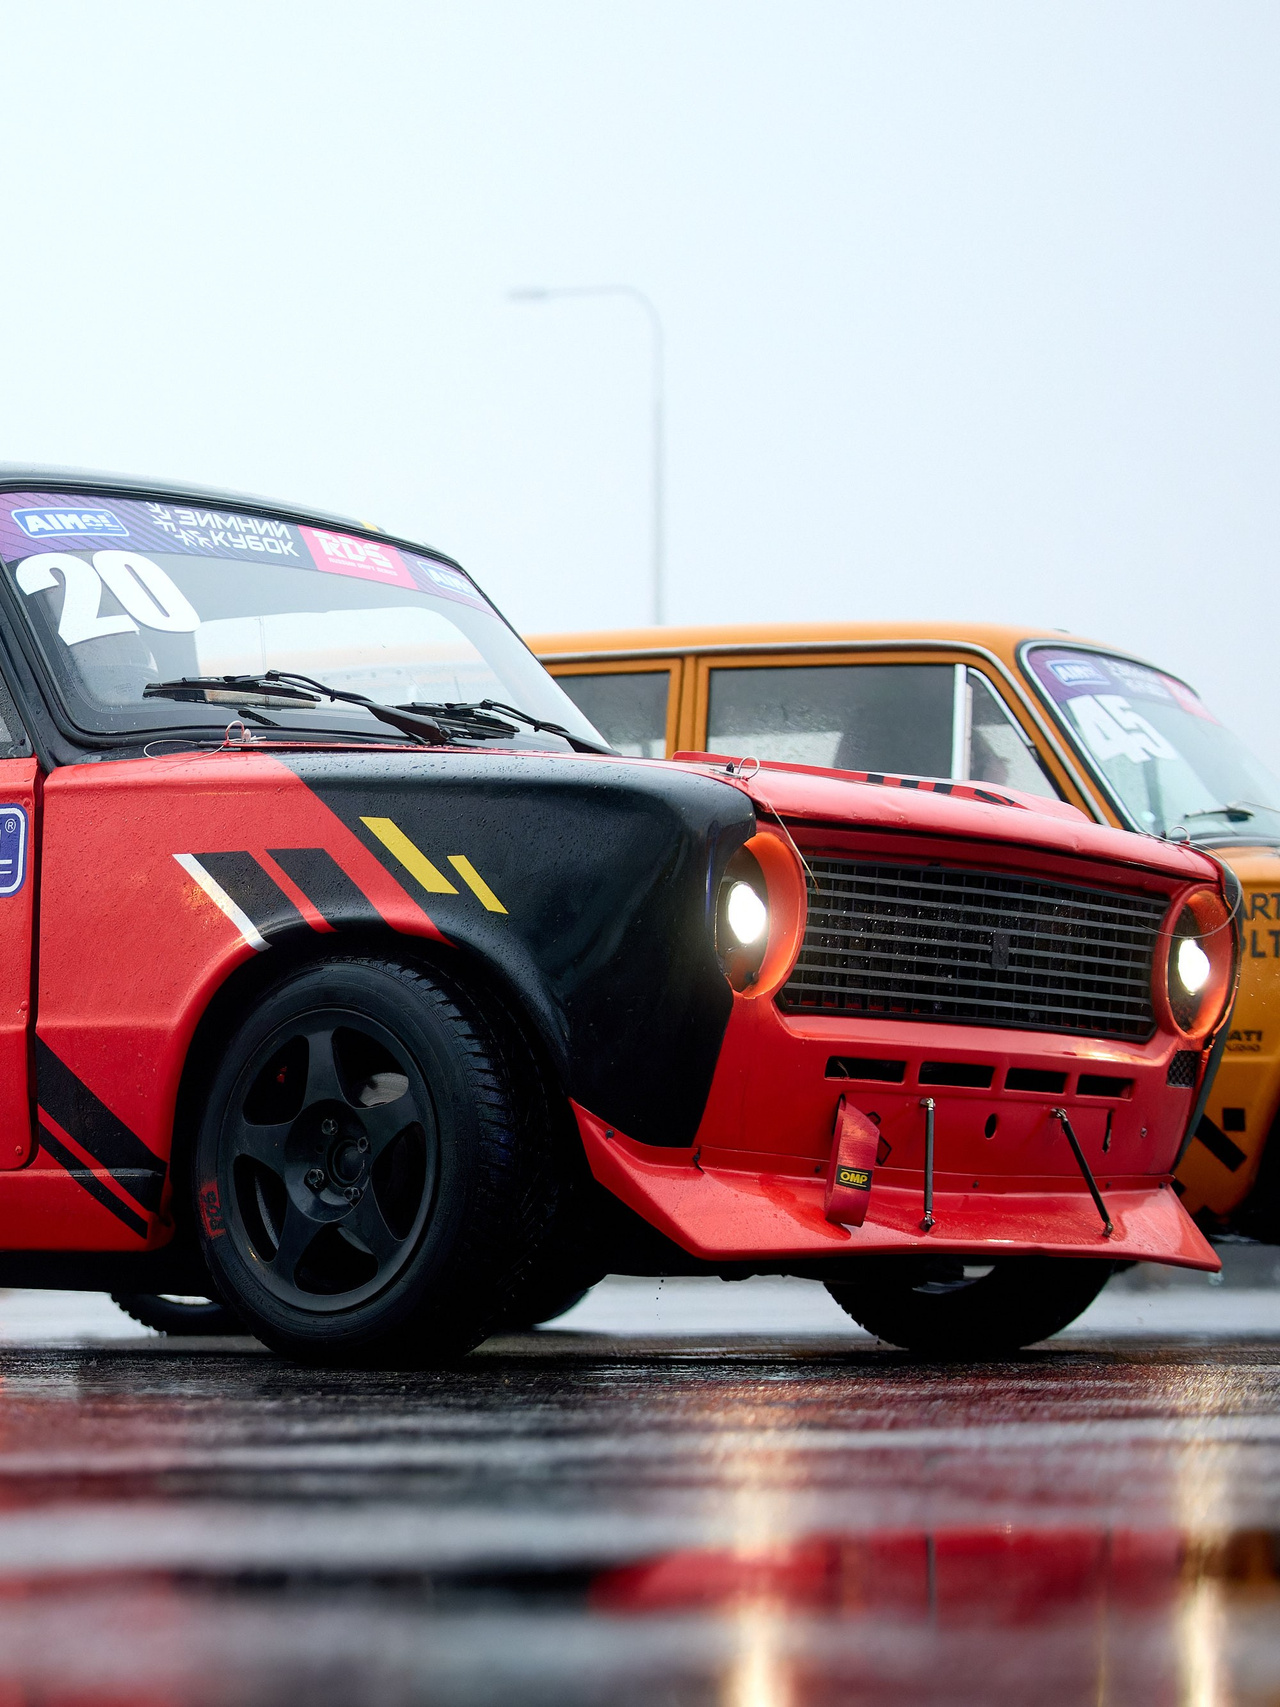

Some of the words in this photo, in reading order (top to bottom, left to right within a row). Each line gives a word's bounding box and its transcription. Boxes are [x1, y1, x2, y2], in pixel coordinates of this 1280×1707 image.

[25, 512, 123, 533] AIMOL
[174, 509, 292, 540] ЗИМНИЙ
[208, 530, 301, 558] КУБОК
[311, 530, 394, 569] RDS
[16, 550, 202, 647] 20
[1066, 693, 1181, 764] 45
[840, 1171, 868, 1185] OMP
